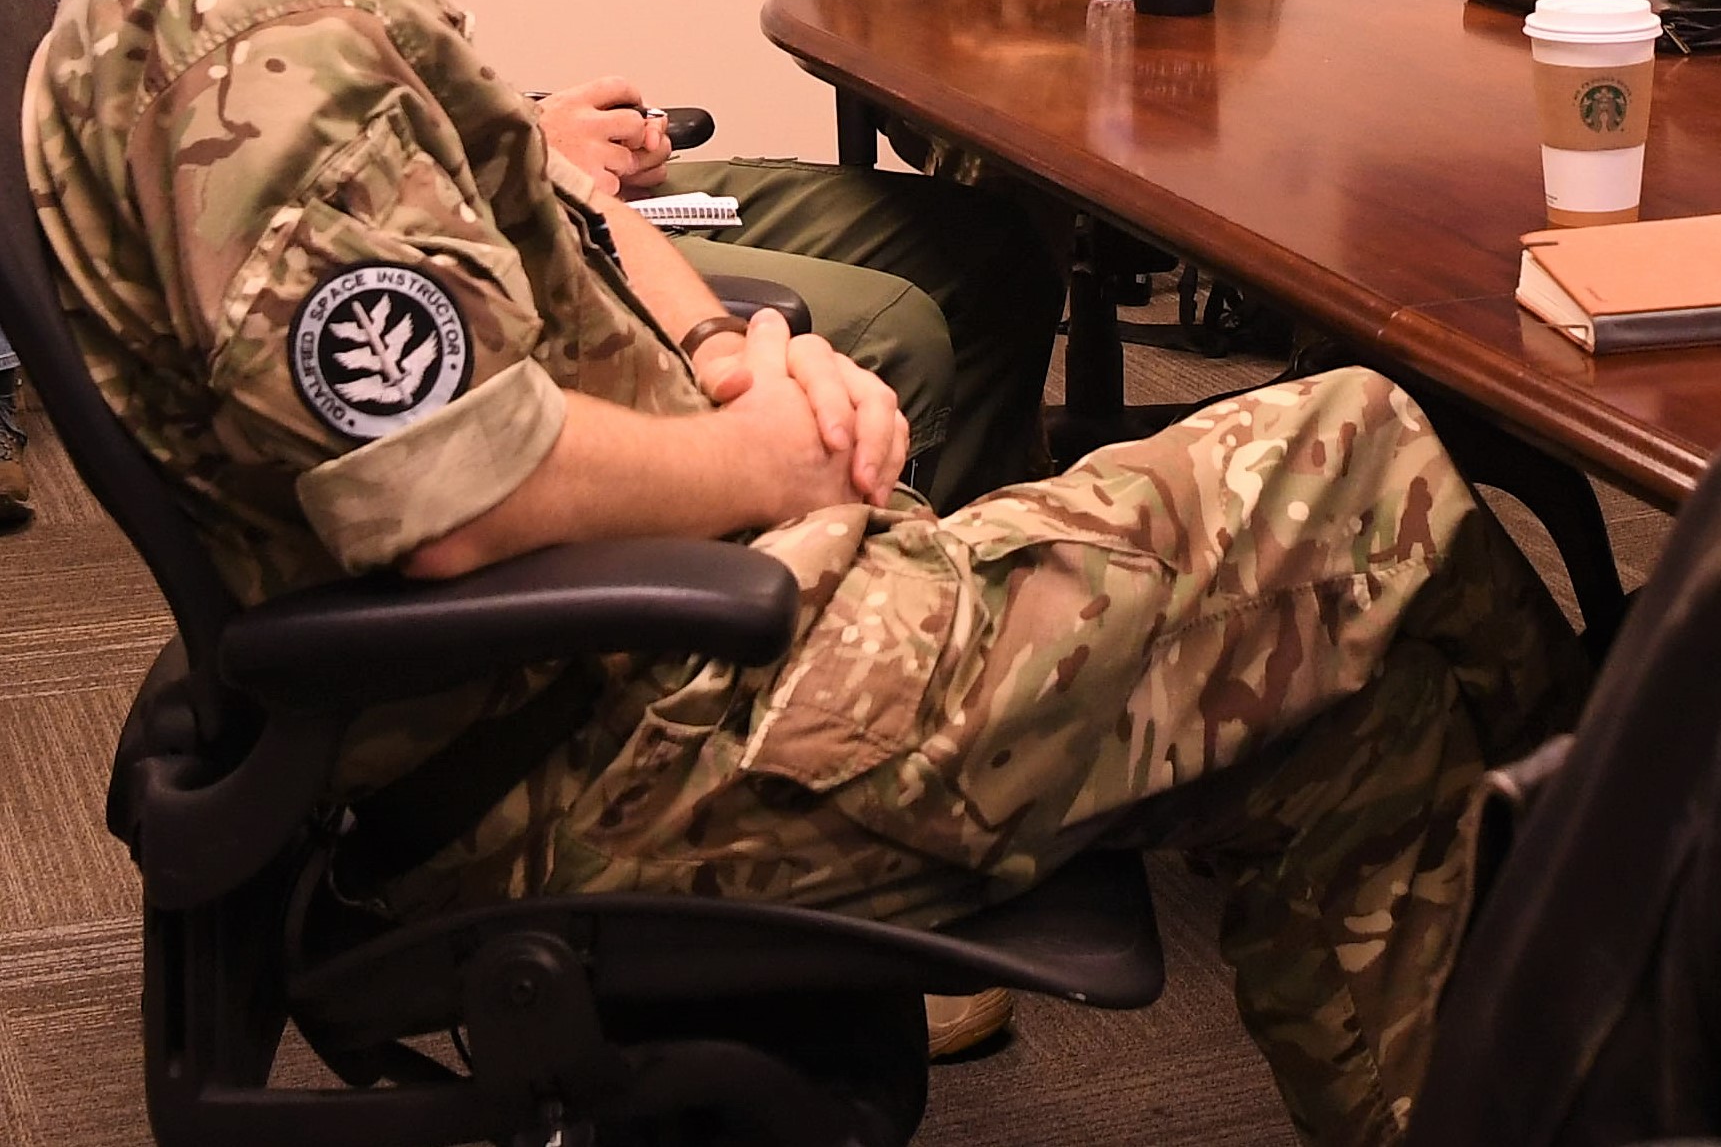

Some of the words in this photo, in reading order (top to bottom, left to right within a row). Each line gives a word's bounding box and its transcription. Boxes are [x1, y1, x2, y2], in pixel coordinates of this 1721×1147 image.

[311, 274, 365, 321] SPACE
[377, 271, 460, 355] INSTRUCTOR
[301, 331, 346, 421] QUALIFIED
